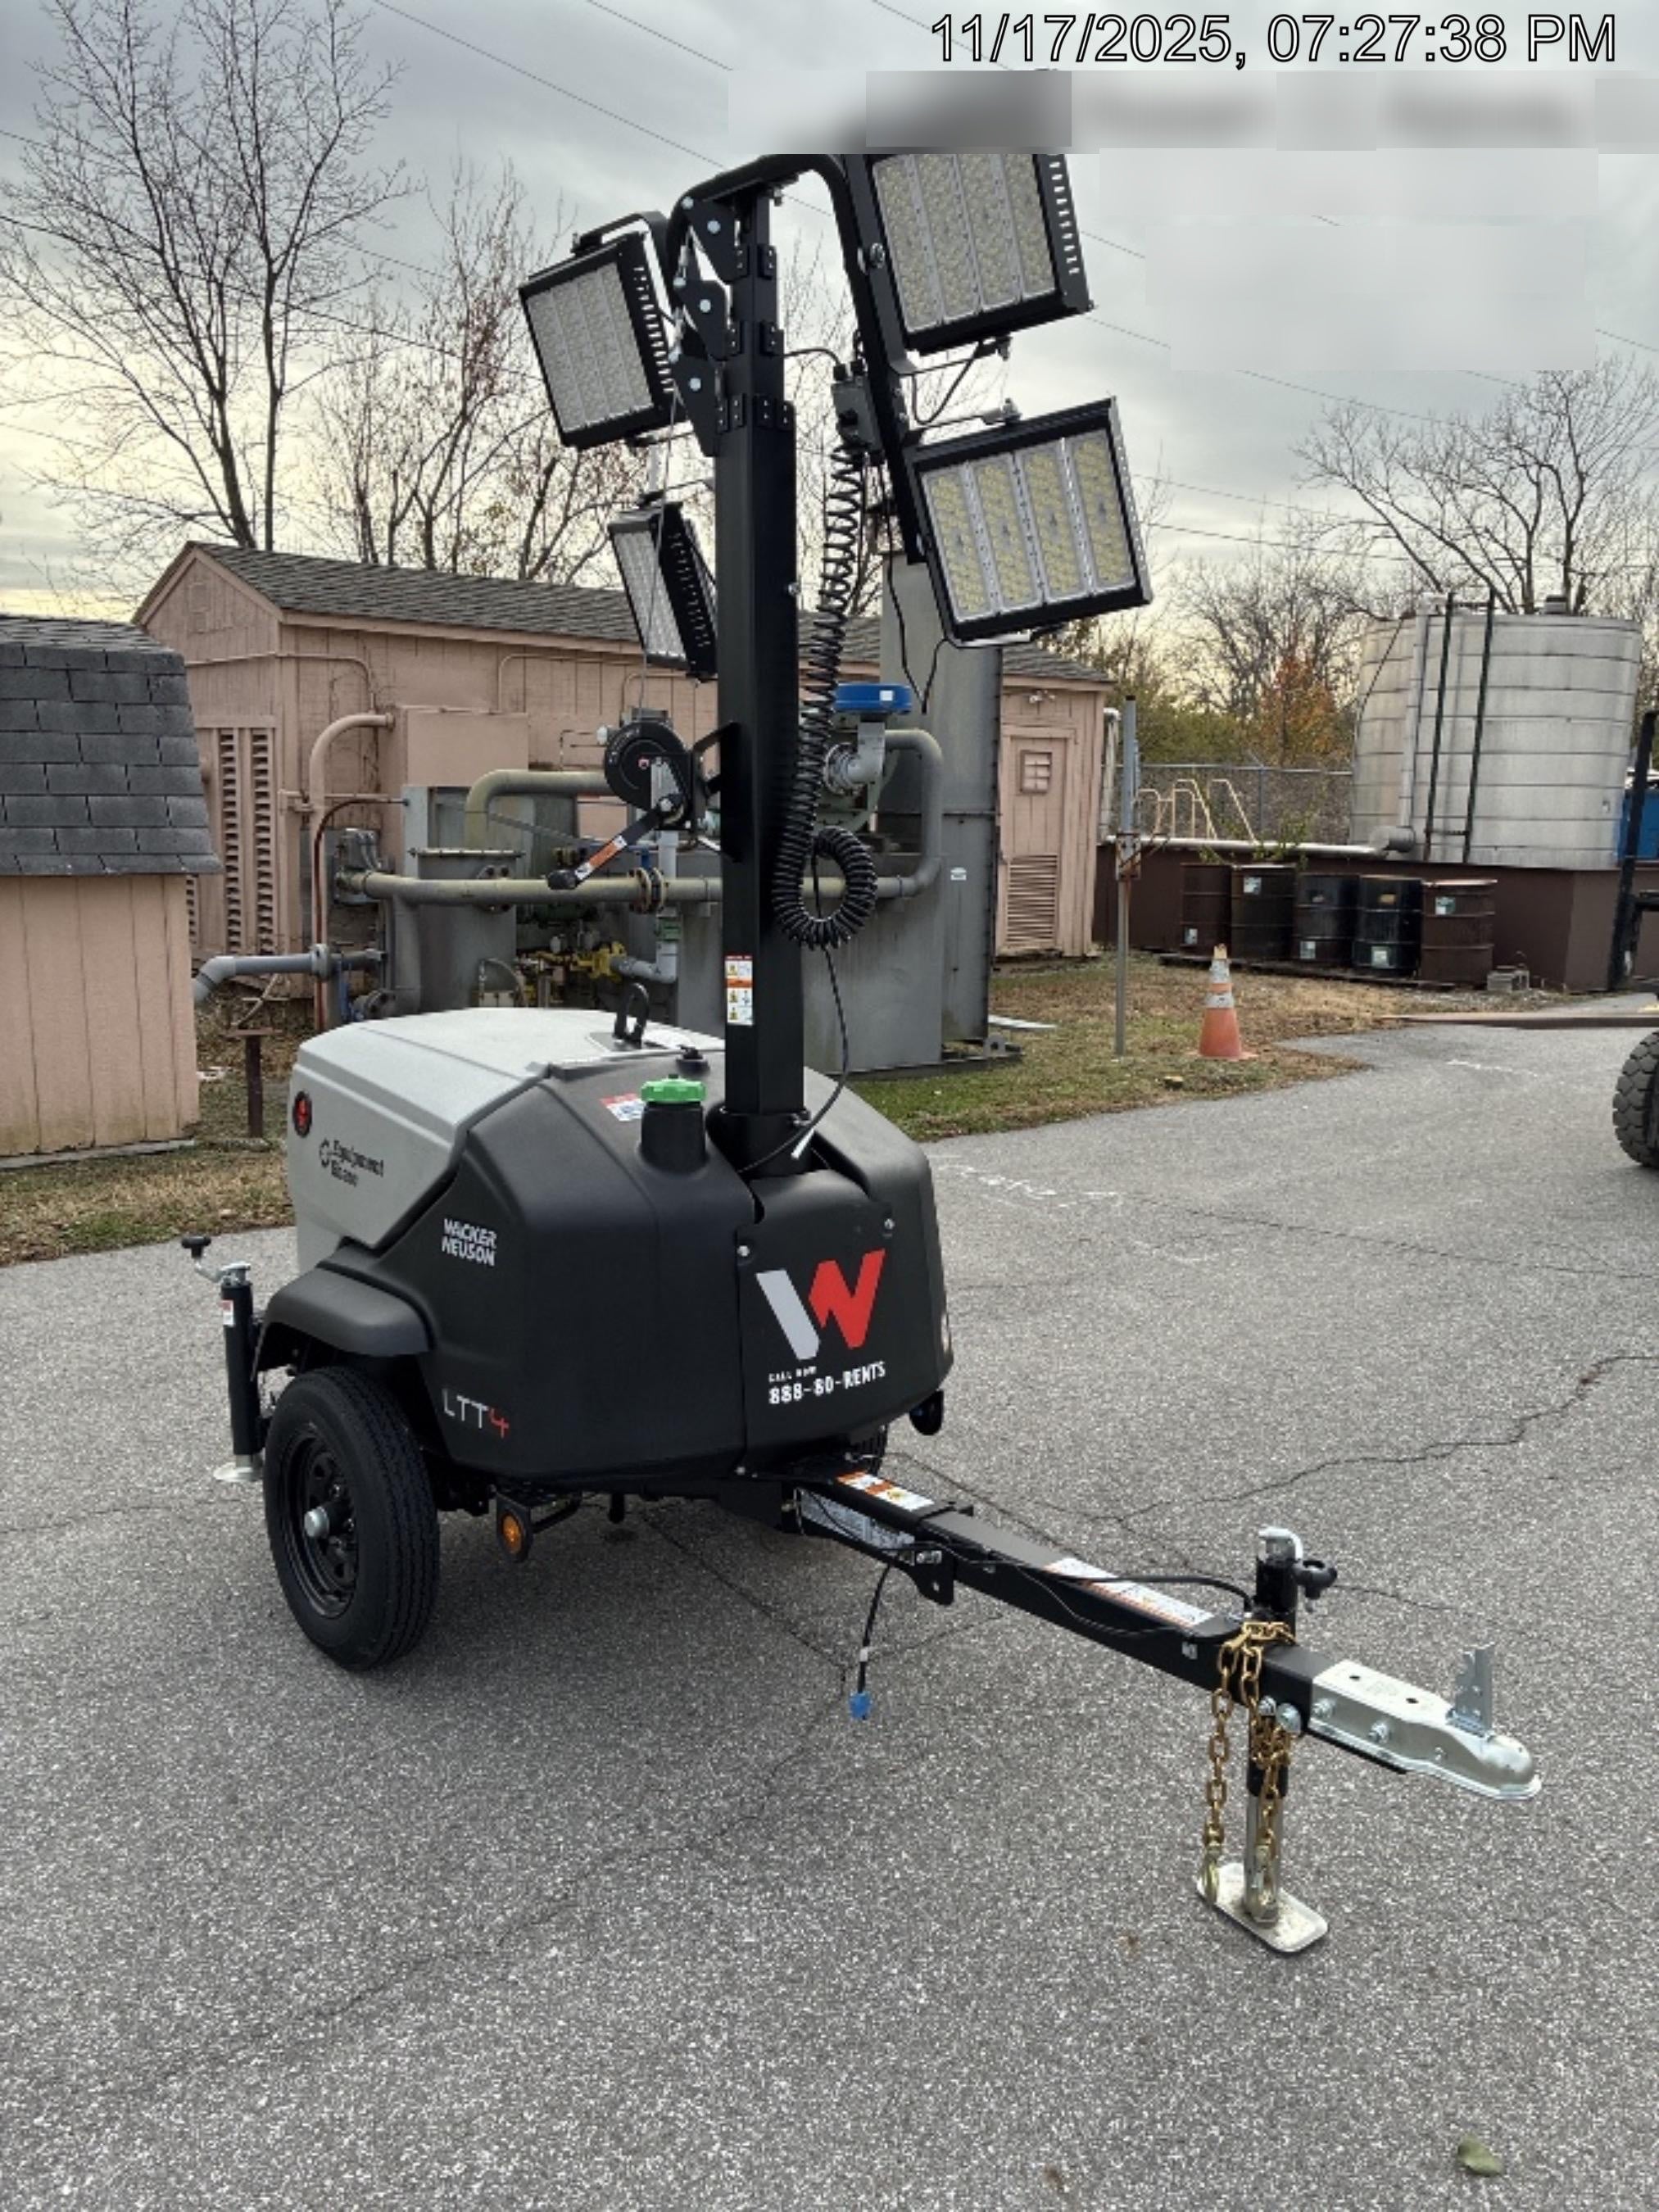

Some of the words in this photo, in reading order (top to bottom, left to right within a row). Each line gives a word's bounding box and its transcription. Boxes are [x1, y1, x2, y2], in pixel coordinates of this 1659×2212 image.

[442, 1235, 495, 1267] NEUSON
[443, 1218, 497, 1249] WACKER
[768, 1360, 886, 1404] 888-80-RENTS
[442, 1389, 510, 1439] LTT4
